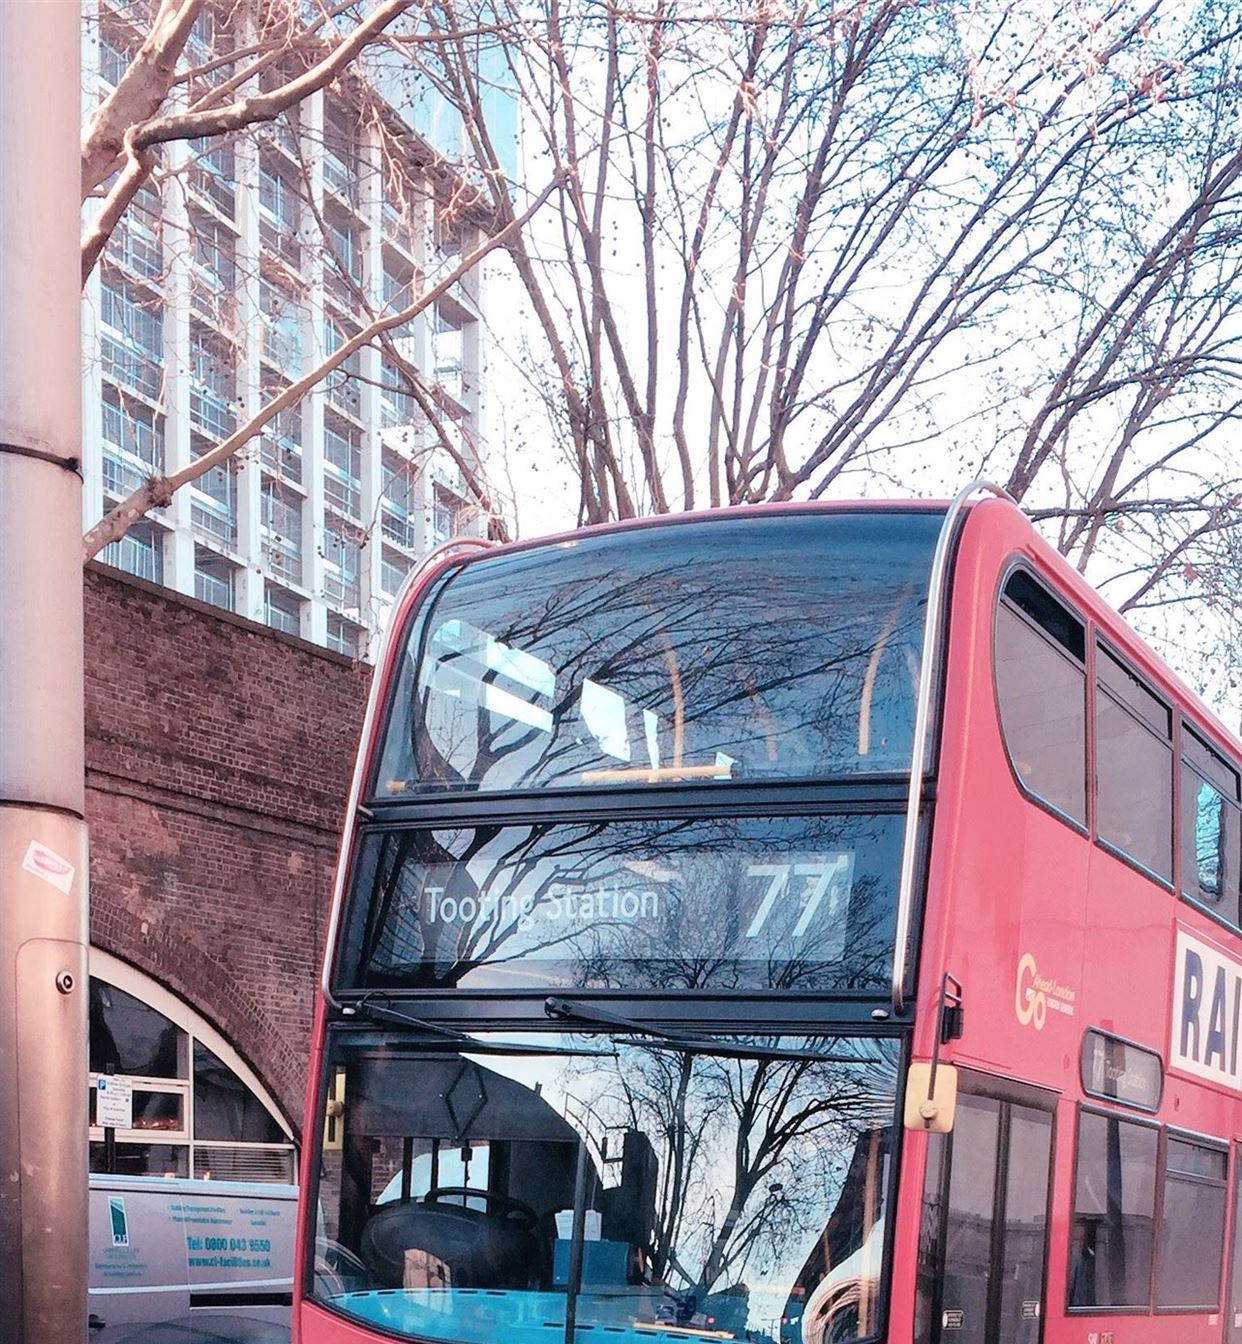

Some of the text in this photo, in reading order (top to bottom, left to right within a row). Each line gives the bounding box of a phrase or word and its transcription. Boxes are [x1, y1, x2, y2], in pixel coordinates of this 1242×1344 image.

[424, 884, 659, 932] Tooting Station
[746, 864, 839, 938] 77
[1015, 952, 1046, 1031] Go
